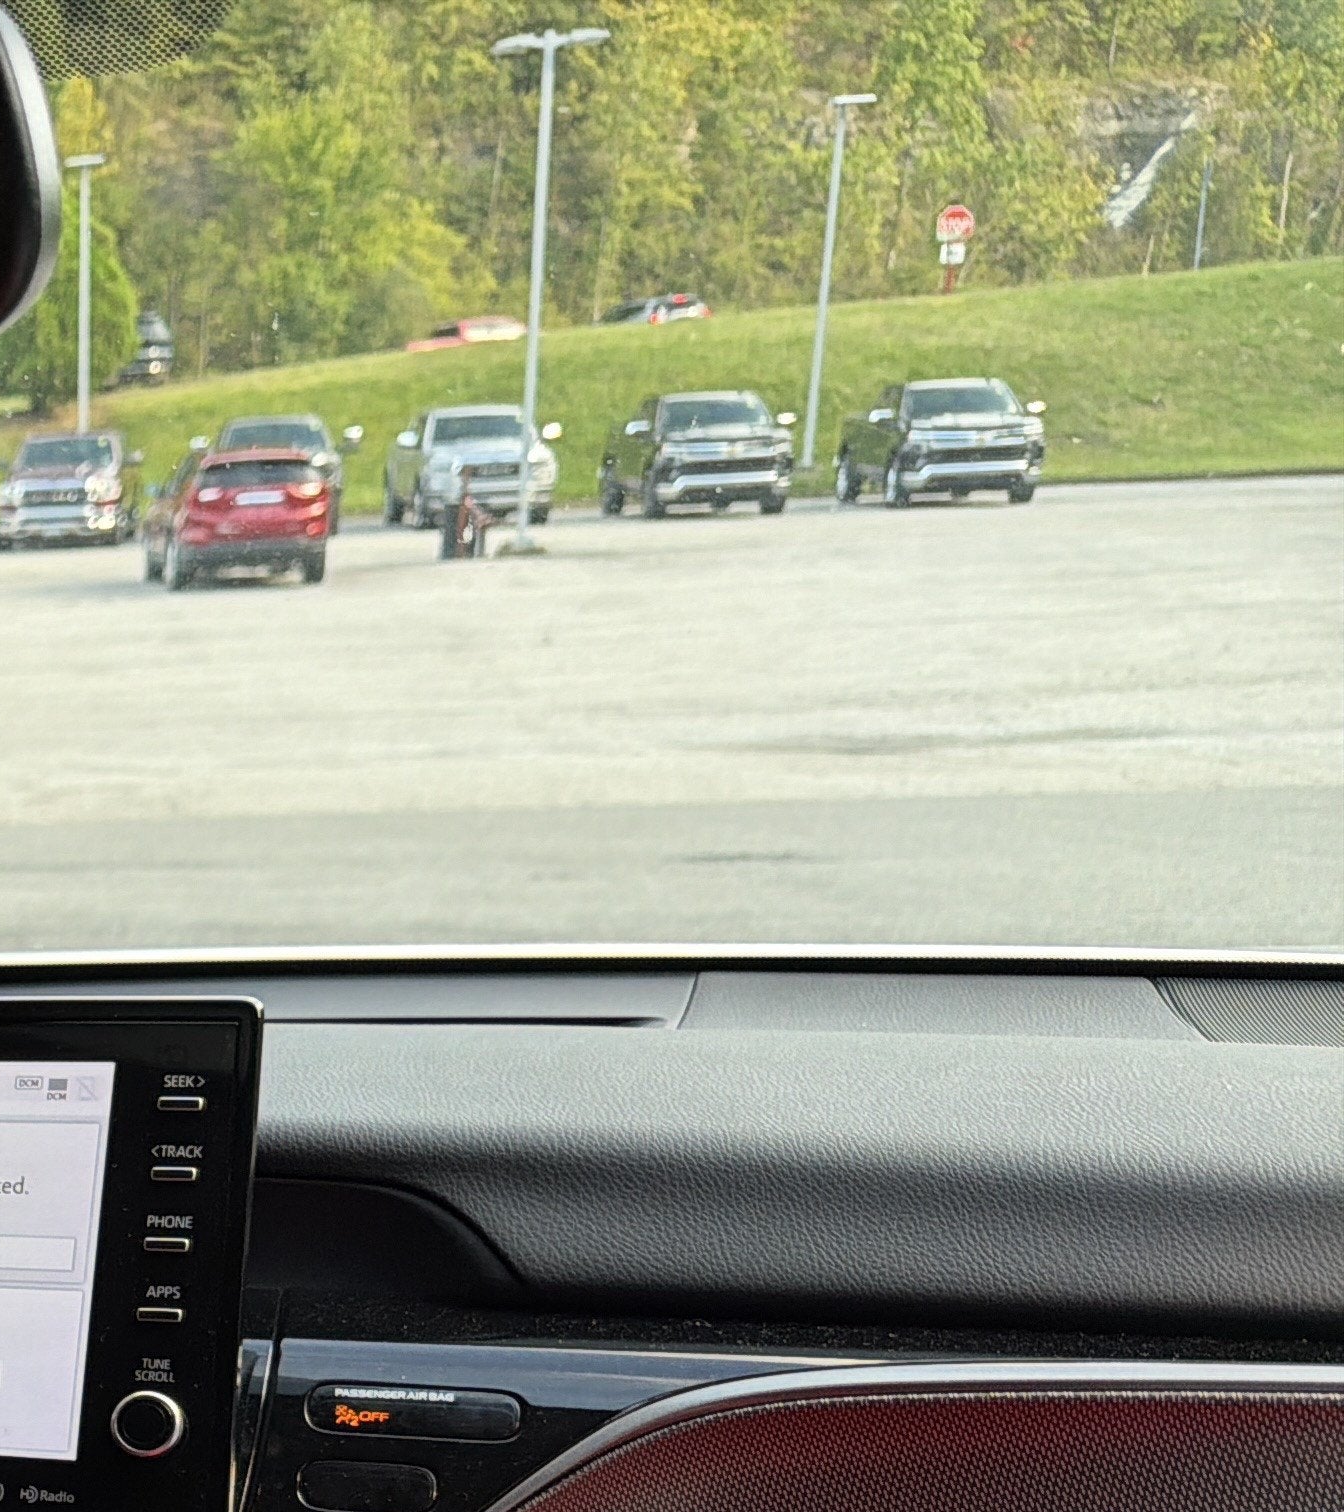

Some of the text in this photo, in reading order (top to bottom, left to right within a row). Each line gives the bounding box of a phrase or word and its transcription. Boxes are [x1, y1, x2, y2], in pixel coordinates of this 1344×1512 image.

[18, 1078, 40, 1088] DCM
[47, 1091, 67, 1101] DCM
[146, 1215, 193, 1229] PHONE
[146, 1285, 181, 1300] APPS
[141, 1358, 171, 1370] TUNE
[135, 1370, 175, 1383] SCROLL
[334, 1388, 454, 1403] PASSENGER AIR BAG
[359, 1411, 390, 1422] OFF
[39, 1489, 75, 1504] Radio
